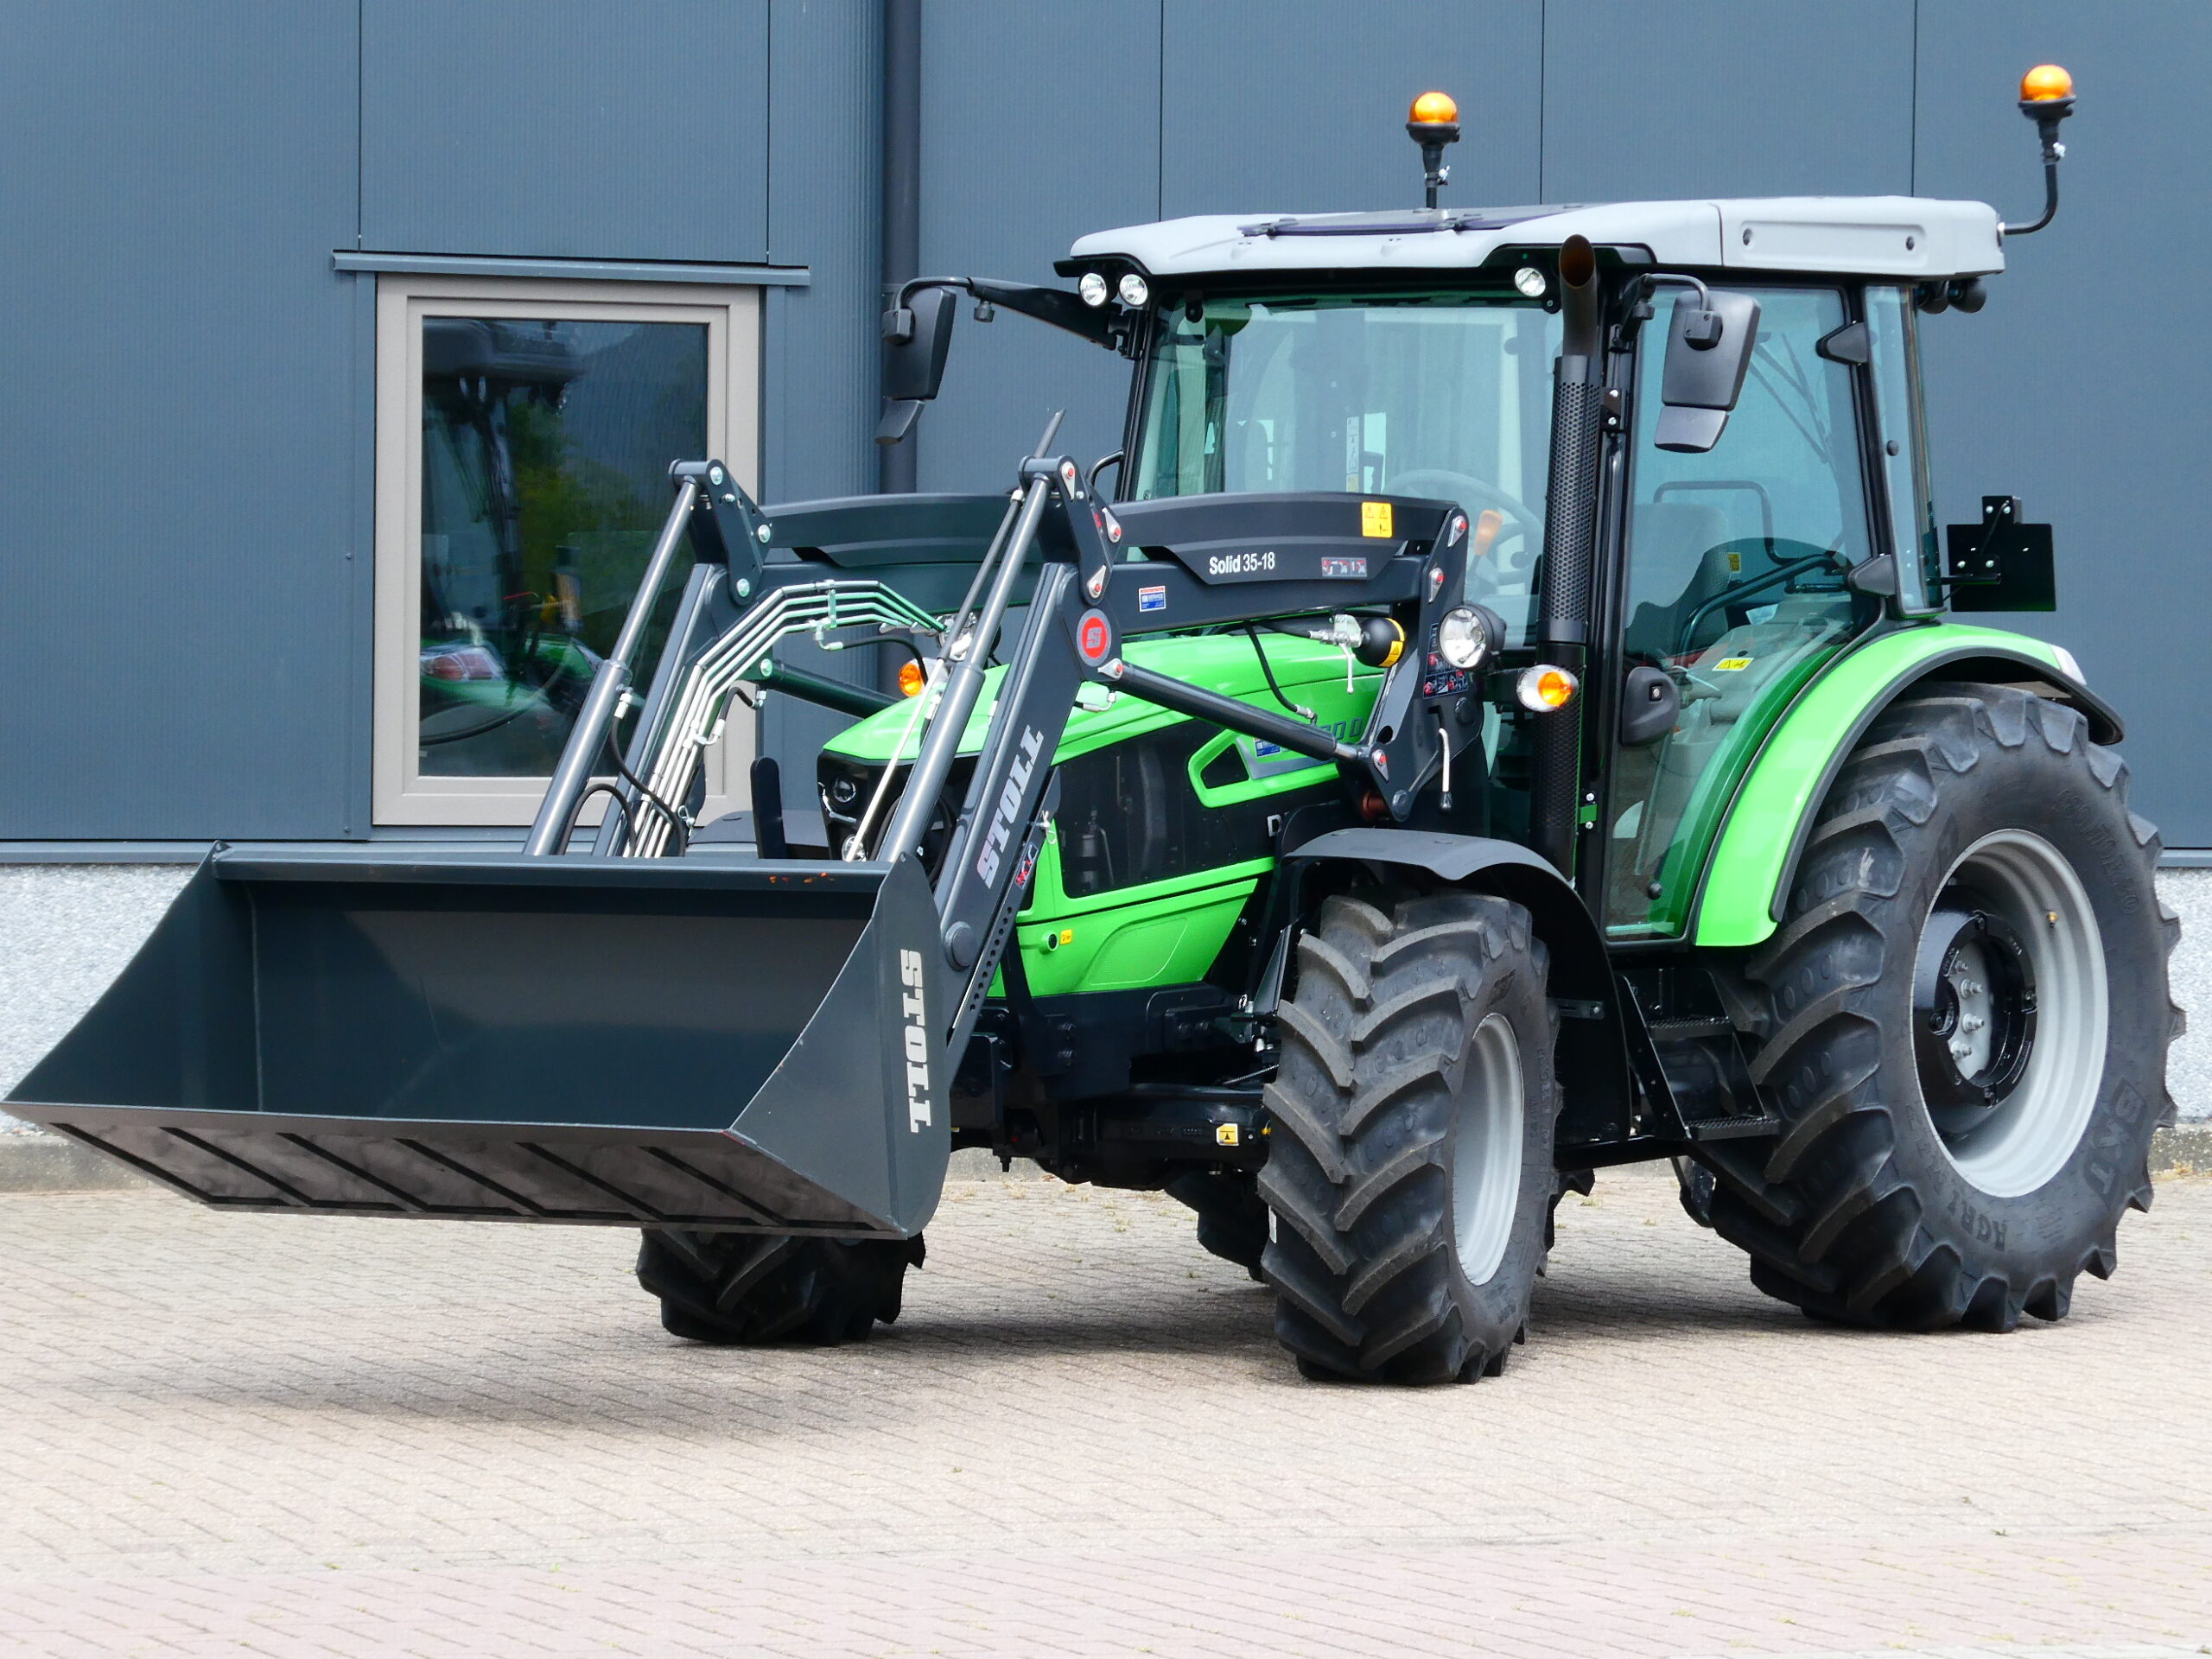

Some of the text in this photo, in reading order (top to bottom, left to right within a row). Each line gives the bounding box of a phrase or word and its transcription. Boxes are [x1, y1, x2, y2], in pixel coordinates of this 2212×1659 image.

[1209, 551, 1275, 575] Solid 35-18
[1086, 627, 1103, 649] S
[976, 724, 1044, 889] STOLL
[900, 949, 931, 1134] STOLL
